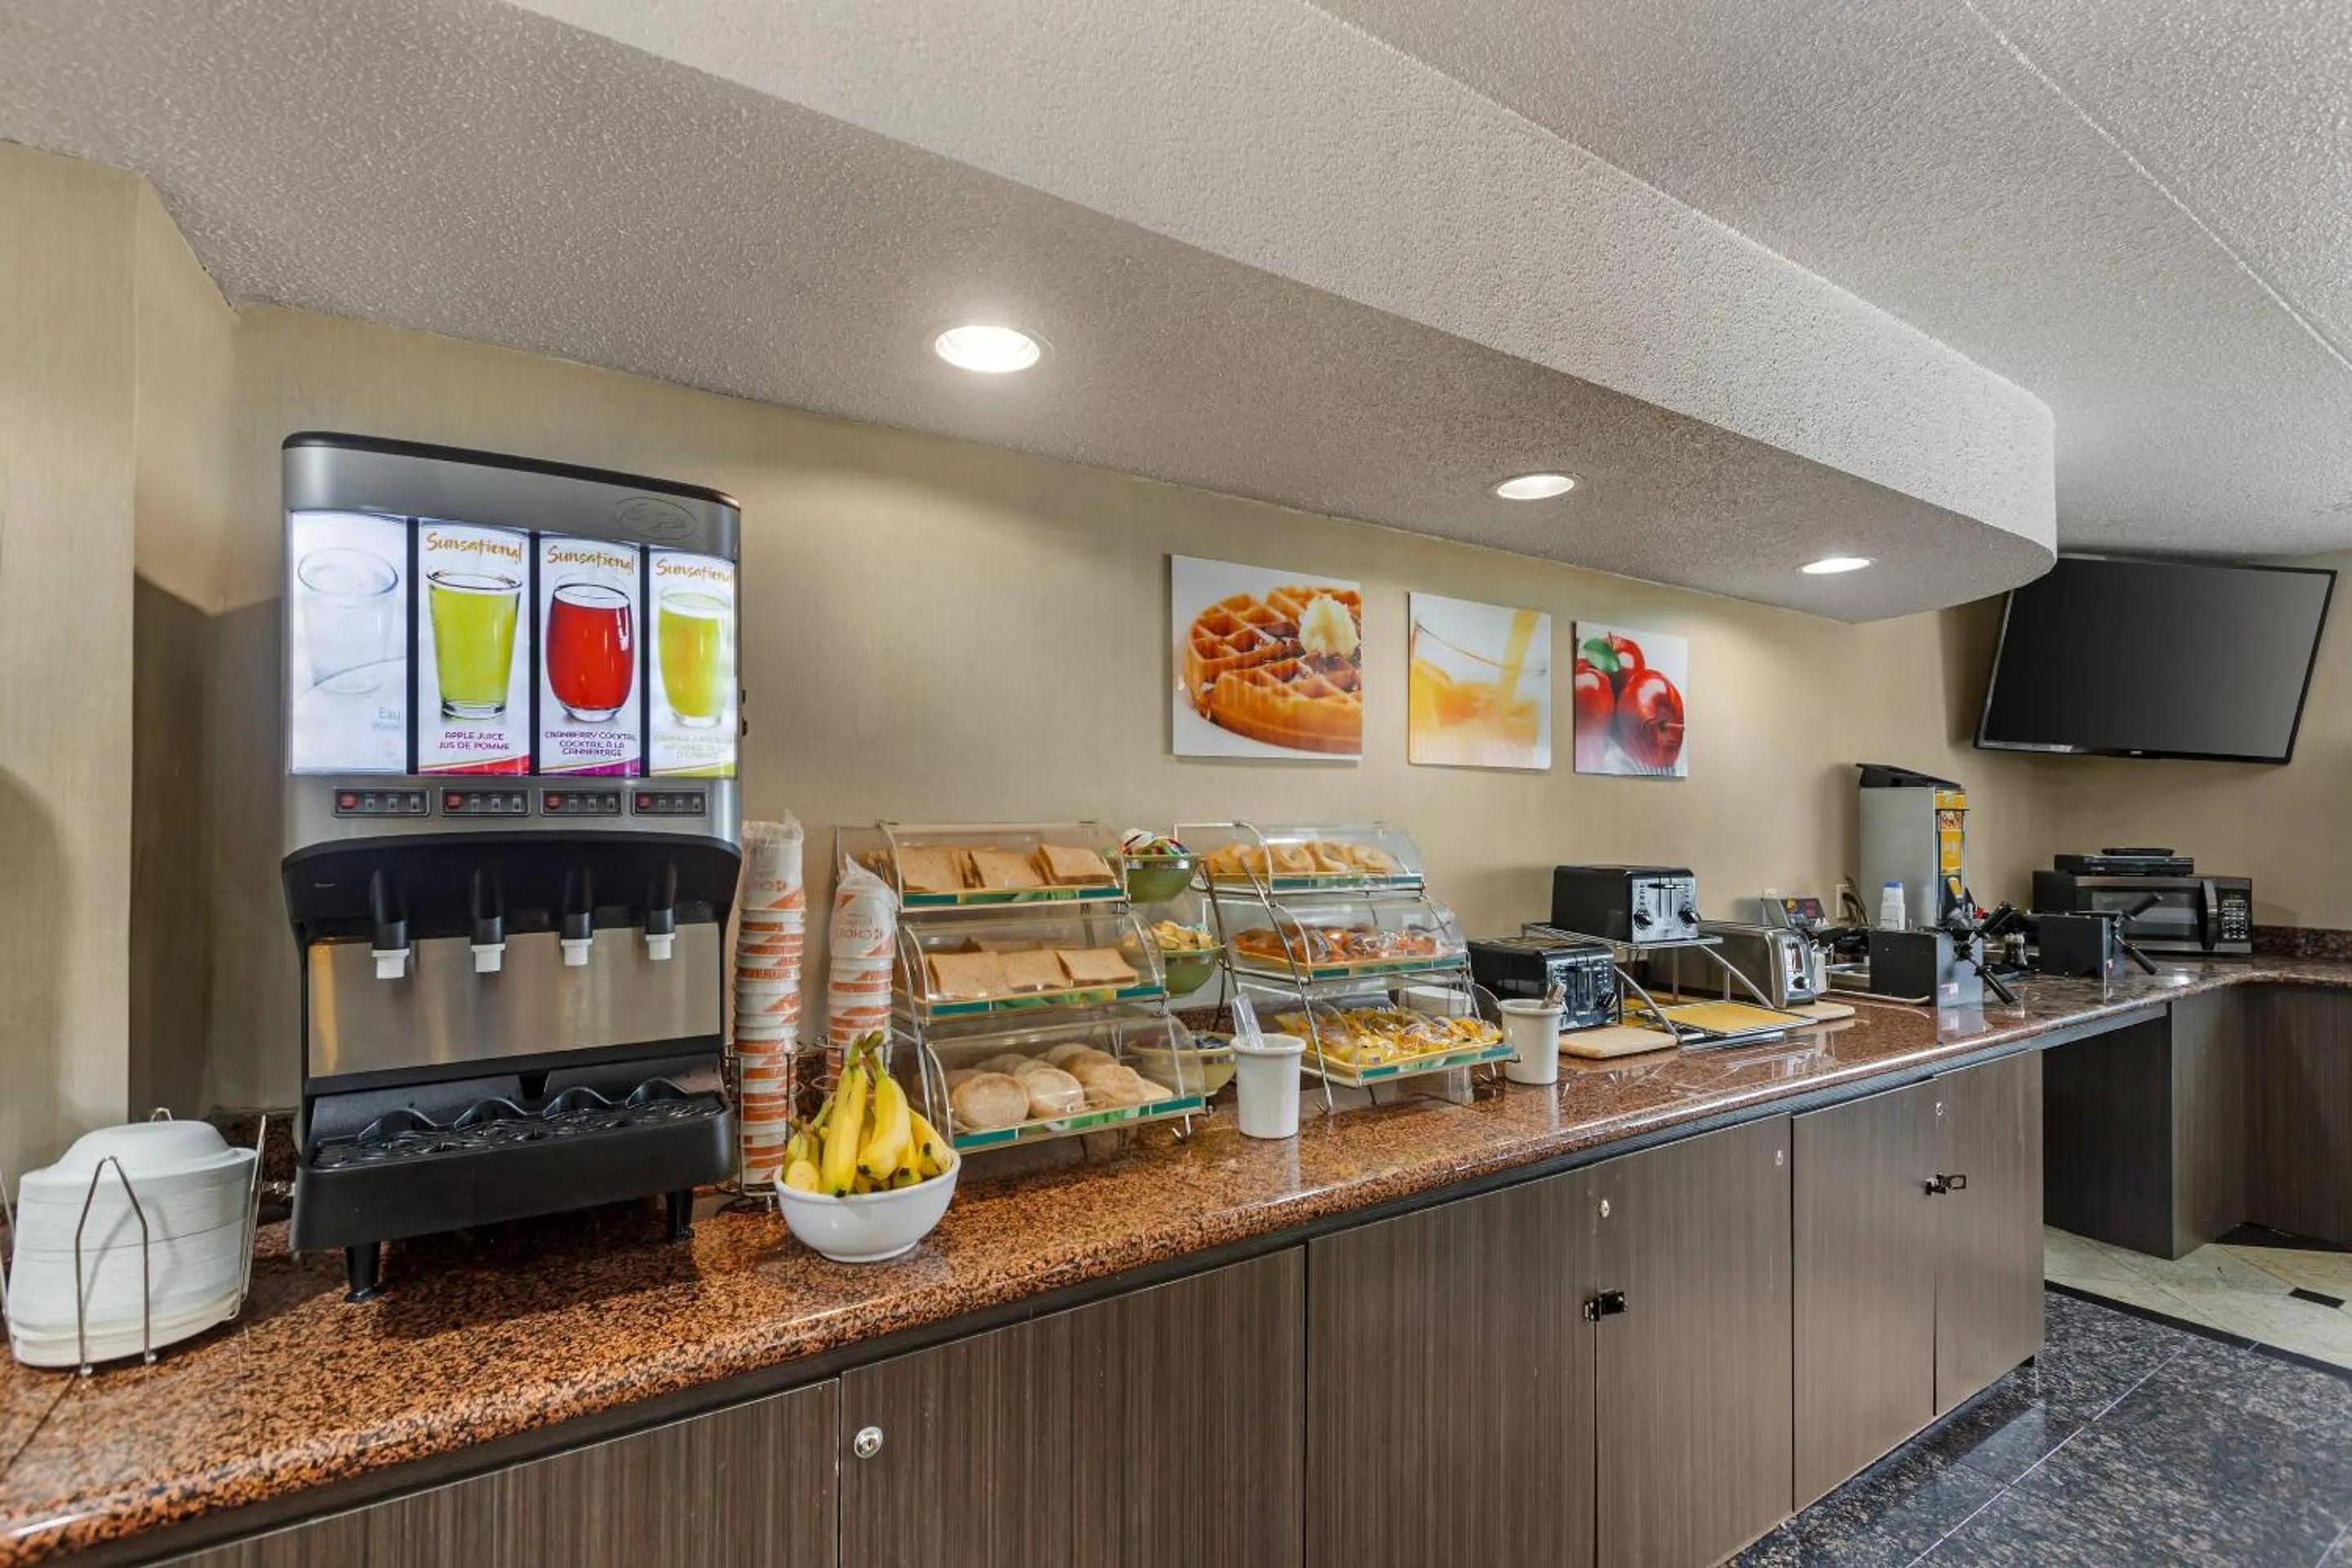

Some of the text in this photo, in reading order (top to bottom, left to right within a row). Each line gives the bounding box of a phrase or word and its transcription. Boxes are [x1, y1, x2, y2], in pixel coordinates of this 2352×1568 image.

[655, 557, 733, 583] Sunsationa
[444, 731, 504, 742] APPLE JUICE
[439, 741, 510, 751] JUS DE POMME
